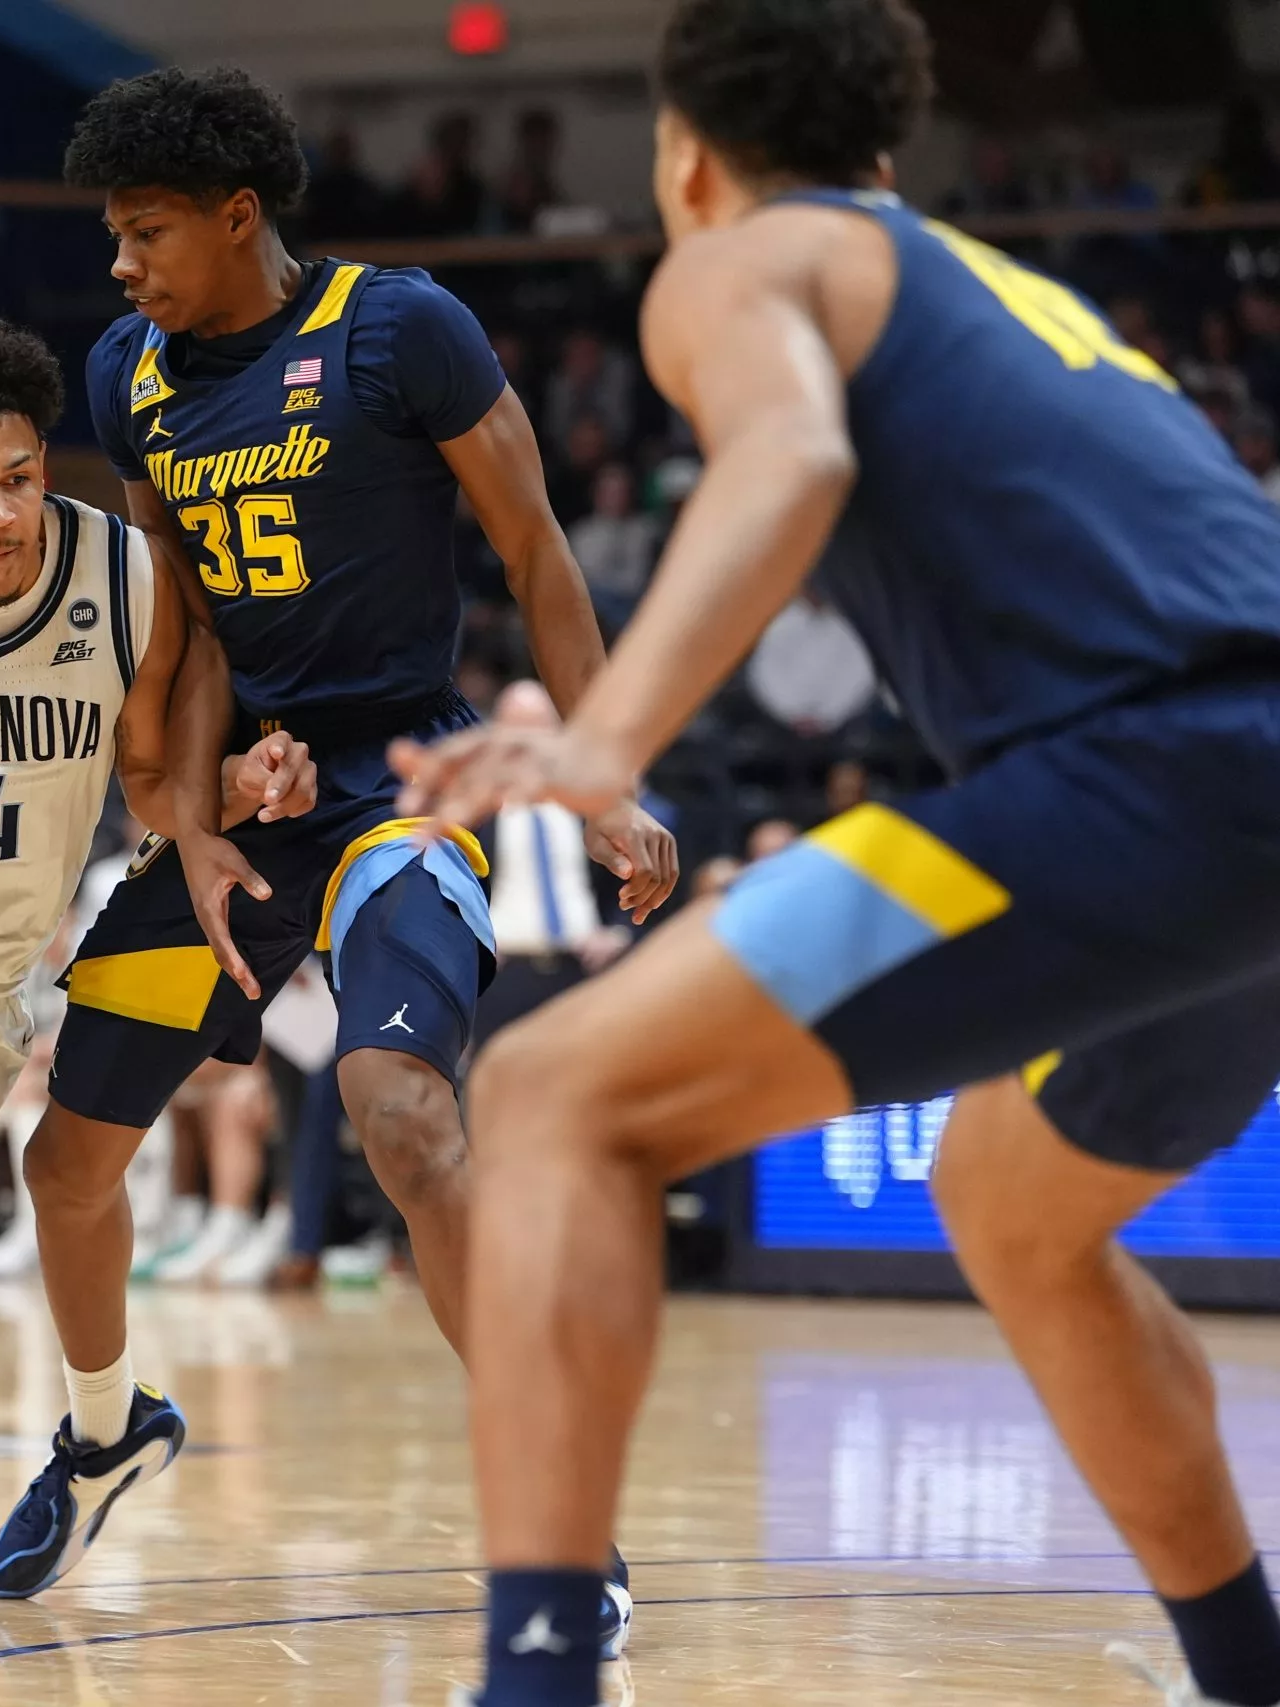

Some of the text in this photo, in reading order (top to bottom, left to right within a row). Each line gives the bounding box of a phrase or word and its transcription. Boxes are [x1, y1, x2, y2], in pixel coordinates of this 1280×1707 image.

[140, 375, 156, 390] THE
[288, 387, 317, 400] BIG
[284, 396, 323, 409] EAST
[143, 424, 331, 501] Marquette
[177, 494, 311, 596] 35
[72, 608, 94, 622] GHR
[57, 639, 87, 652] BIG
[53, 647, 96, 661] EAST
